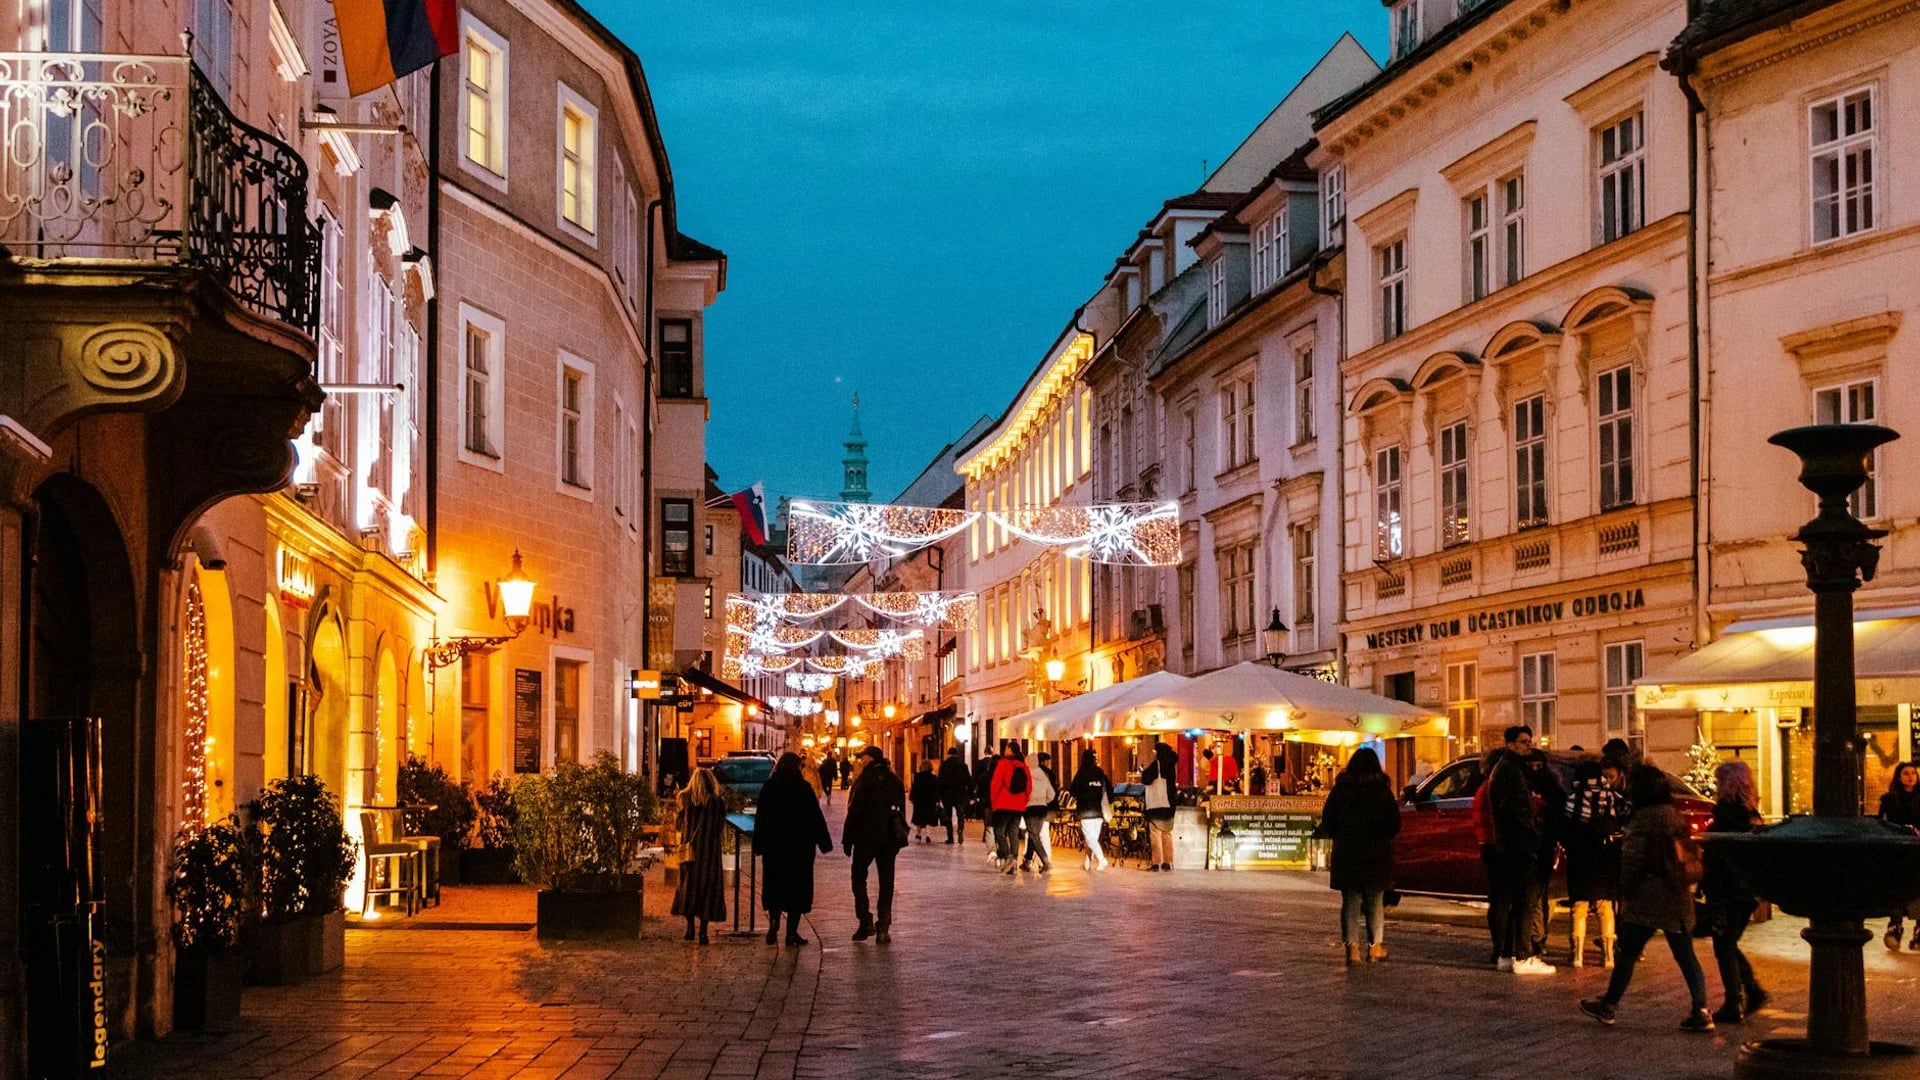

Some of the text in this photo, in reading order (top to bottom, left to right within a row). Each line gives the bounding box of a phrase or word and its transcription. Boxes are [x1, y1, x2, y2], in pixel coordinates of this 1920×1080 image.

[323, 17, 338, 66] ZOYA
[1430, 619, 1460, 640] DOM
[1572, 588, 1645, 617] ODBOJA
[1212, 799, 1239, 809] CAMEL
[1241, 799, 1298, 809] RESTAURANT
[89, 939, 107, 1068] legendary
